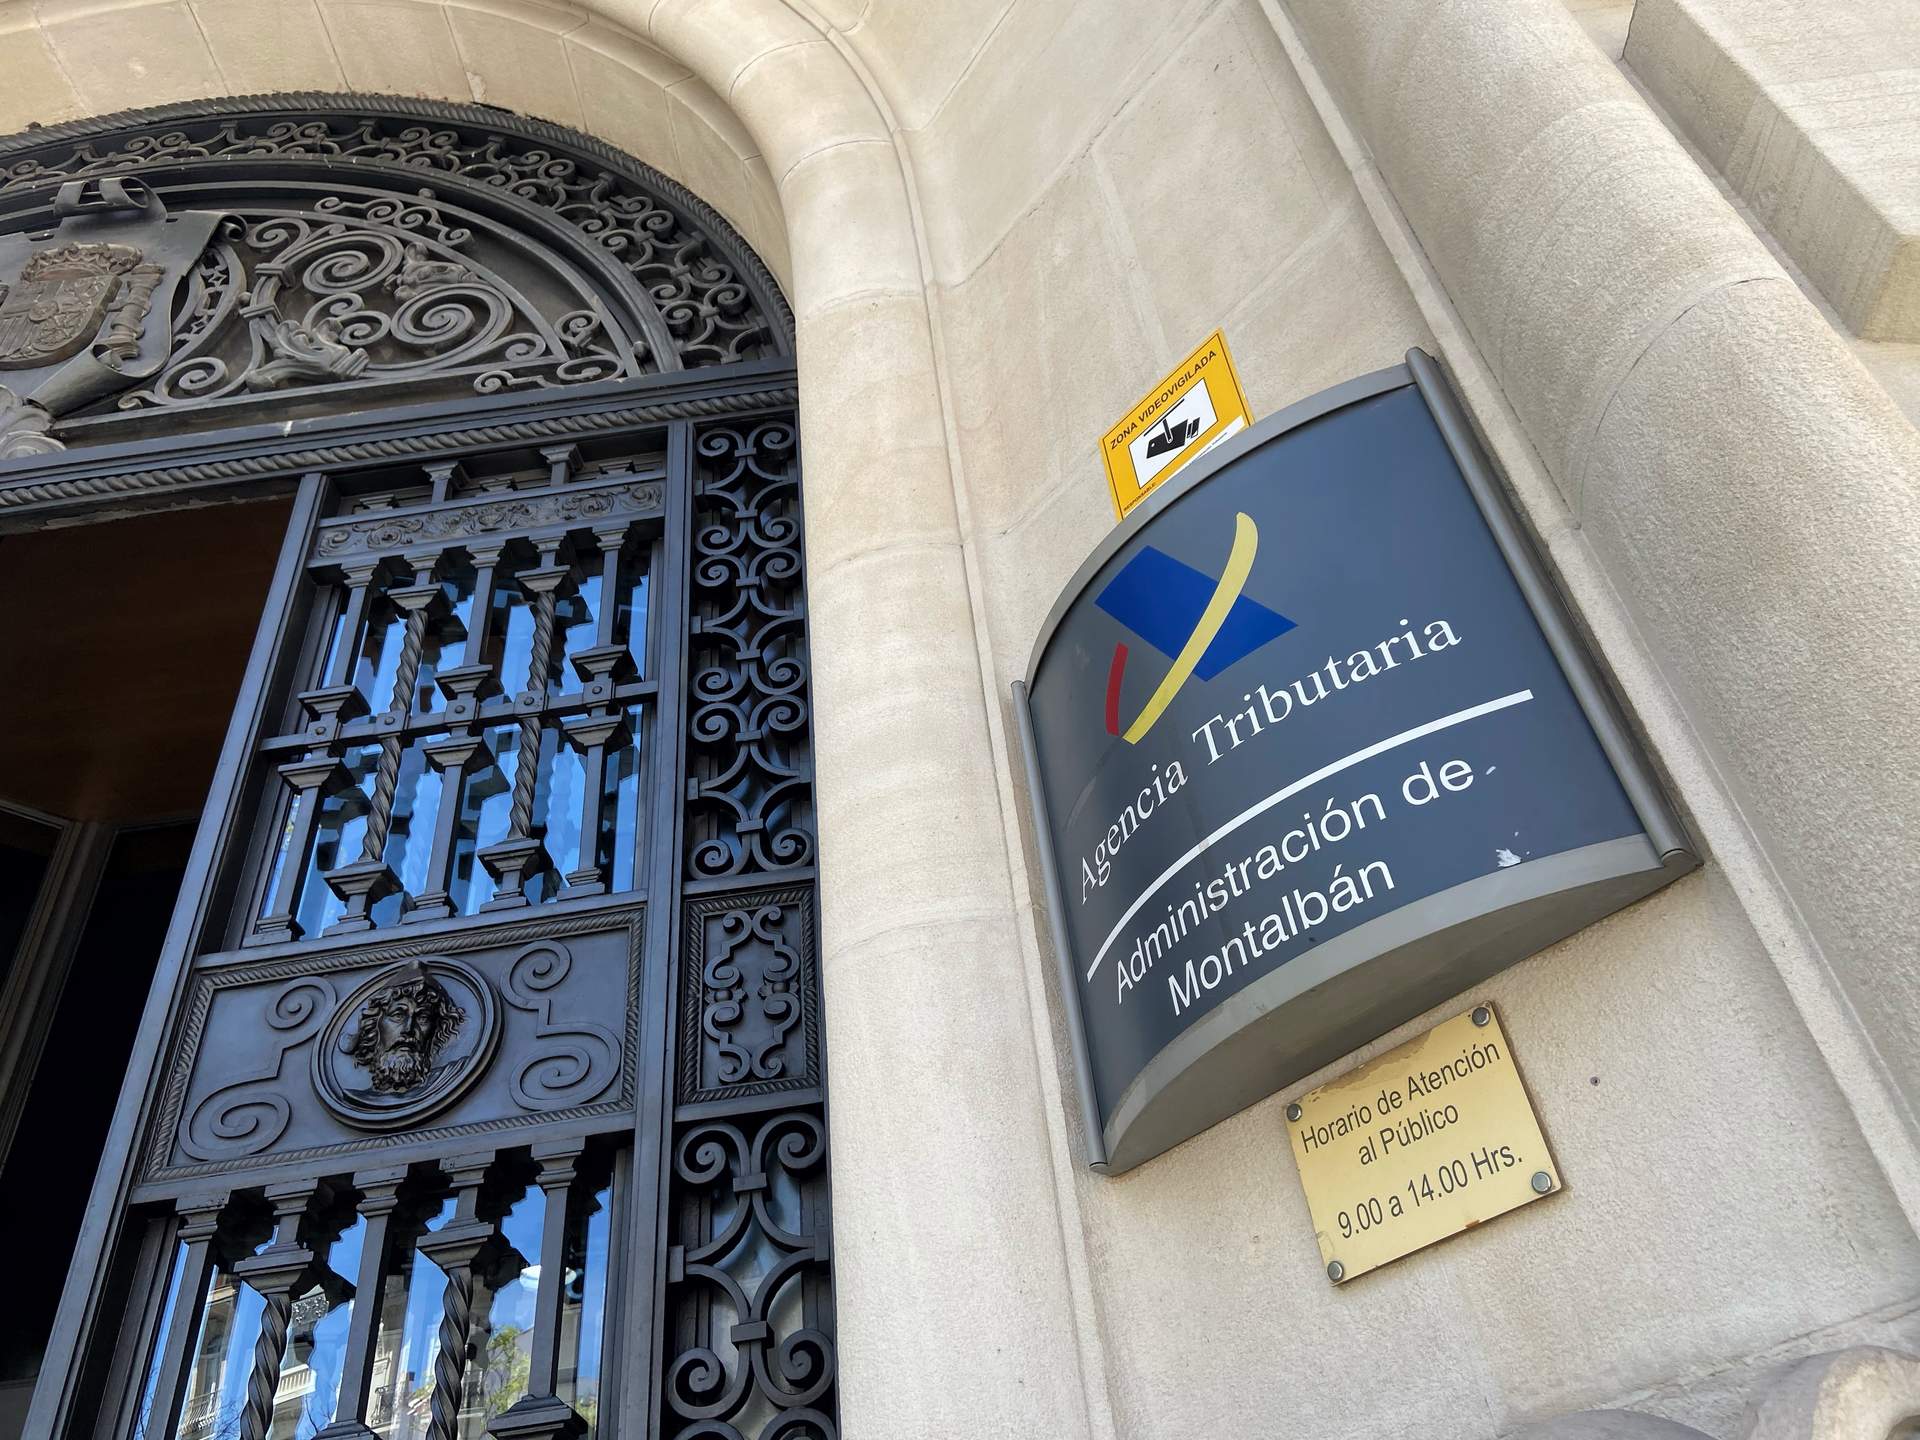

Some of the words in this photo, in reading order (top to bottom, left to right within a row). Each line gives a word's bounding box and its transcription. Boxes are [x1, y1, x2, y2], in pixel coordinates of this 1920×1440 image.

[1110, 423, 1138, 450] ZONA
[1138, 350, 1217, 422] VIDEOVIGILADA
[1082, 758, 1189, 903] Agencia
[1192, 618, 1462, 766] Tributaria
[1117, 791, 1387, 1004] Administración
[1402, 758, 1474, 806] de
[1168, 858, 1395, 1016] Montalbán
[1301, 1104, 1372, 1154] Horario
[1377, 1090, 1403, 1116] de
[1407, 1043, 1500, 1101] Atención
[1358, 1136, 1378, 1166] al
[1380, 1104, 1459, 1156] Público
[1338, 1197, 1383, 1239] 9.00
[1388, 1196, 1404, 1217] a
[1407, 1159, 1468, 1207] 14.00
[1471, 1145, 1523, 1180] Hrs.
